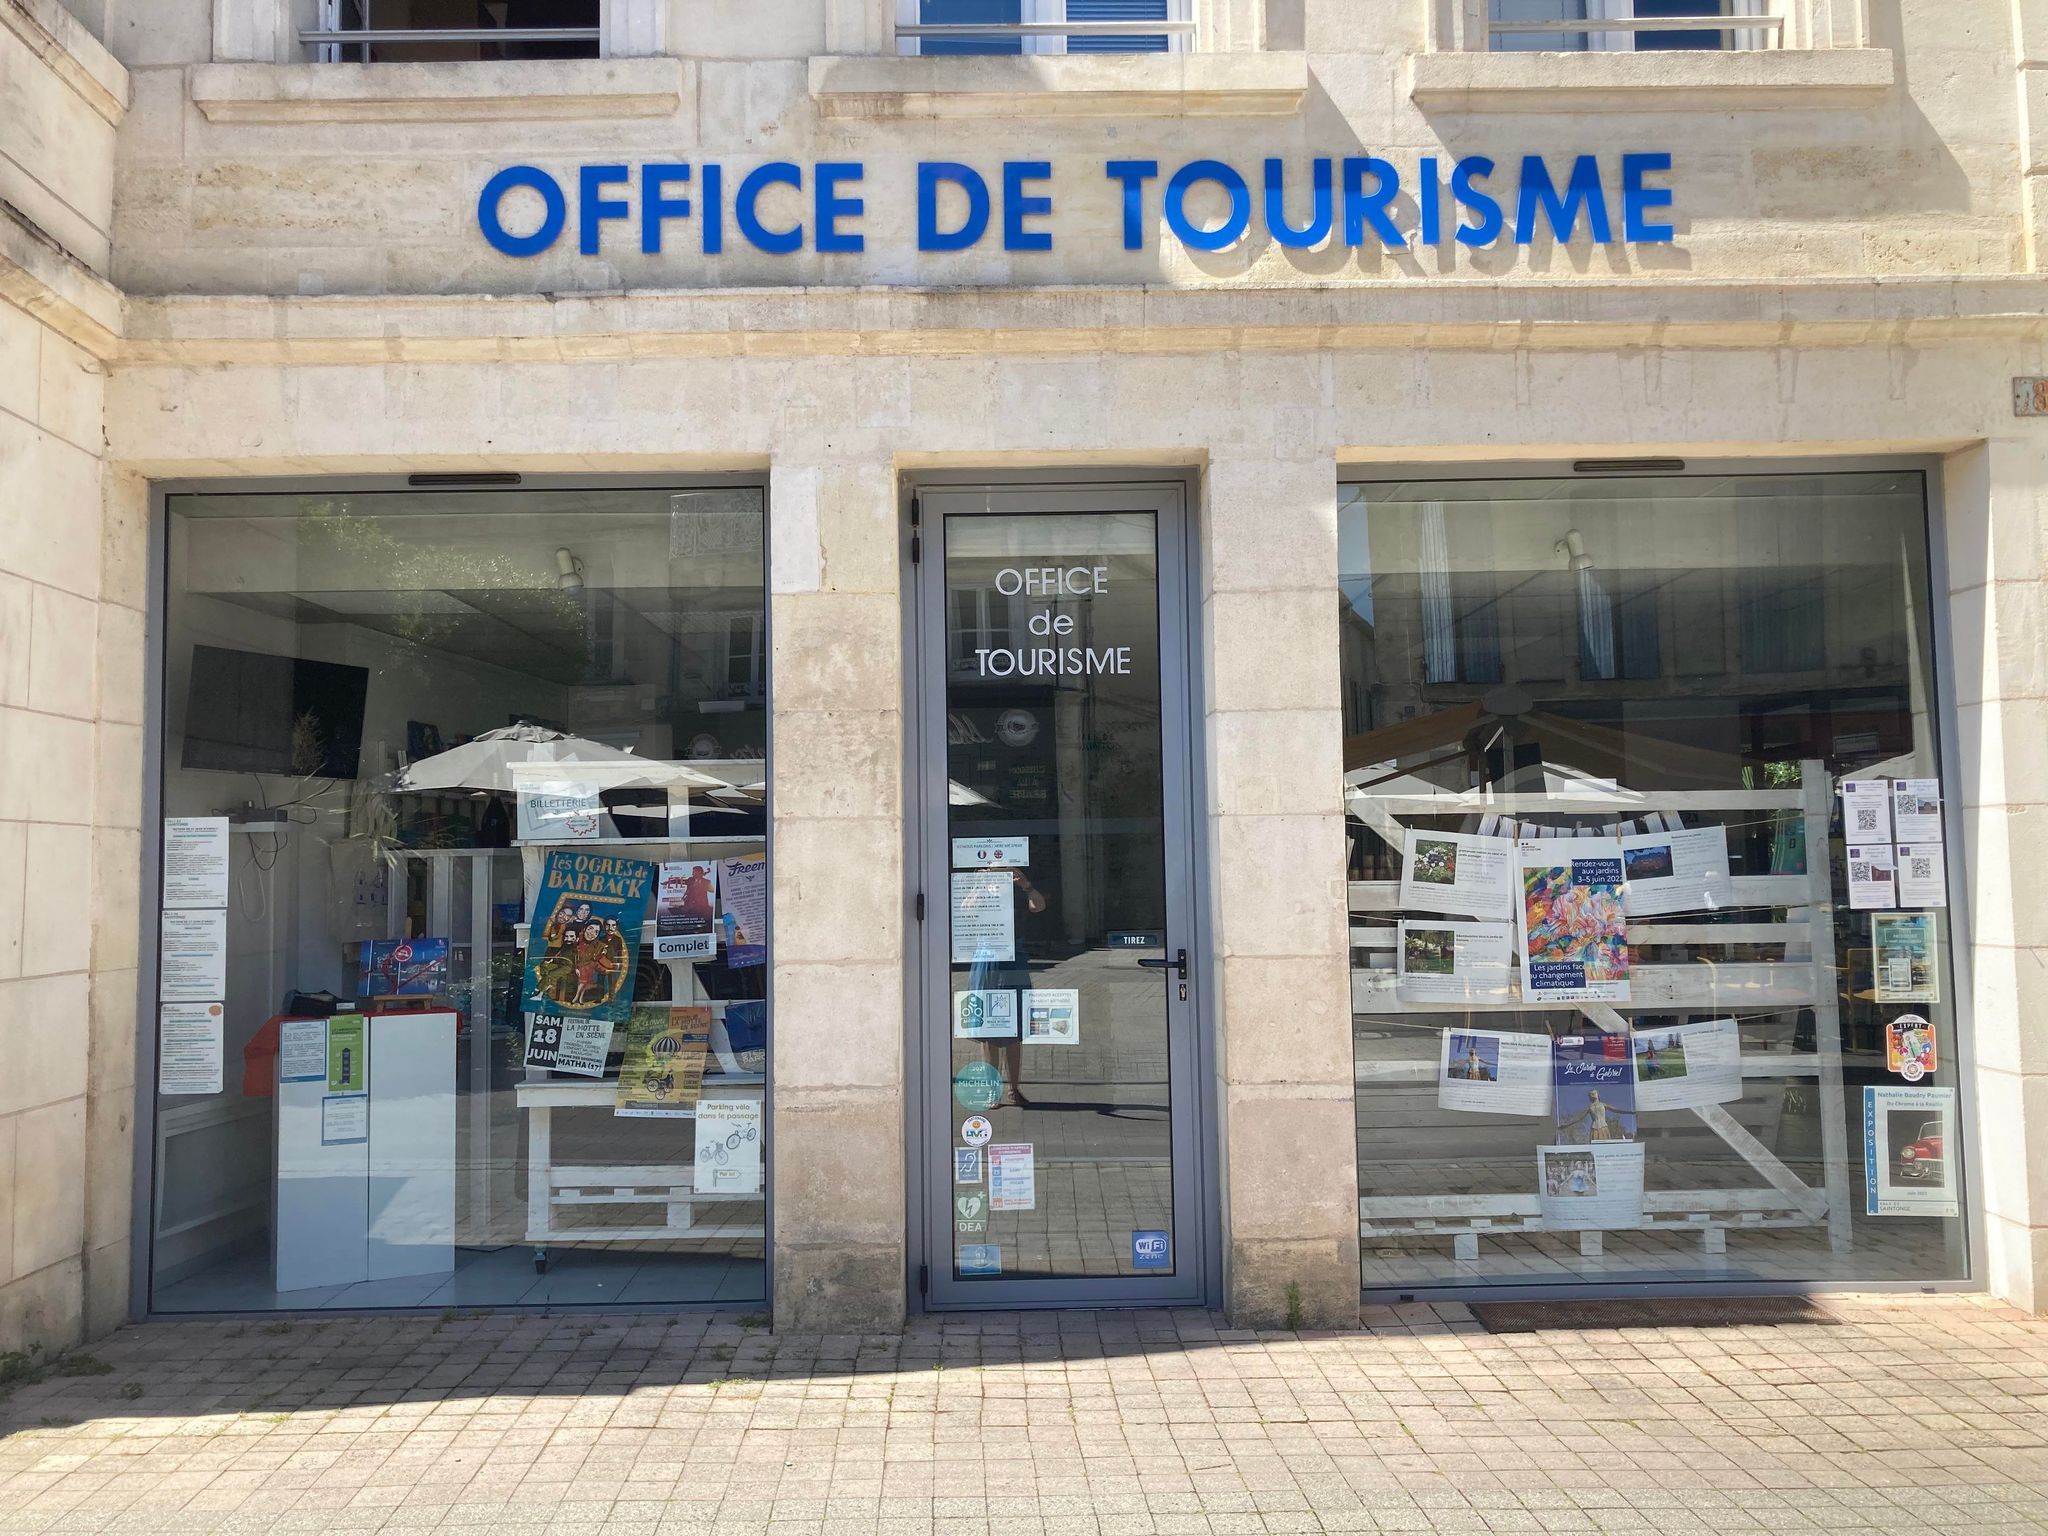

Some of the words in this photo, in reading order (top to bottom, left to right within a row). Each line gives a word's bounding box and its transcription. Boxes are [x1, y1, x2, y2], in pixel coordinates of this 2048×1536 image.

[478, 162, 864, 257] OFFICE
[917, 161, 1052, 252] DE
[1106, 152, 1674, 252] TOURISME
[995, 566, 1108, 596] OFFICE
[1028, 609, 1074, 636] de
[975, 646, 1131, 676] TOURISME
[530, 798, 587, 809] BILLETTERIE
[574, 856, 634, 876] OGRES
[1595, 867, 1620, 876] jardins
[548, 869, 646, 898] BARBACK
[1591, 876, 1606, 884] juin
[1123, 936, 1145, 945] TIREZ
[658, 940, 710, 954] Complet
[1546, 963, 1571, 972] jardins
[1538, 972, 1584, 981] changement
[1535, 980, 1575, 989] climatique
[535, 1014, 564, 1028] SAM.
[577, 1024, 601, 1032] MOTTE
[532, 1028, 557, 1044] 18
[575, 1031, 584, 1039] EN
[527, 1047, 558, 1062] JUIN
[557, 1058, 587, 1069] MATHA
[588, 1062, 602, 1071] (17)
[1596, 1067, 1622, 1080] Gabriel
[958, 1079, 1000, 1088] MICHELIN
[706, 1103, 734, 1111] Parking
[735, 1103, 750, 1111] vélo
[697, 1112, 717, 1120] dans
[717, 1112, 726, 1120] le
[726, 1113, 759, 1121] passage
[1867, 1101, 1877, 1194] EXPOSITION
[959, 1222, 983, 1232] DEA
